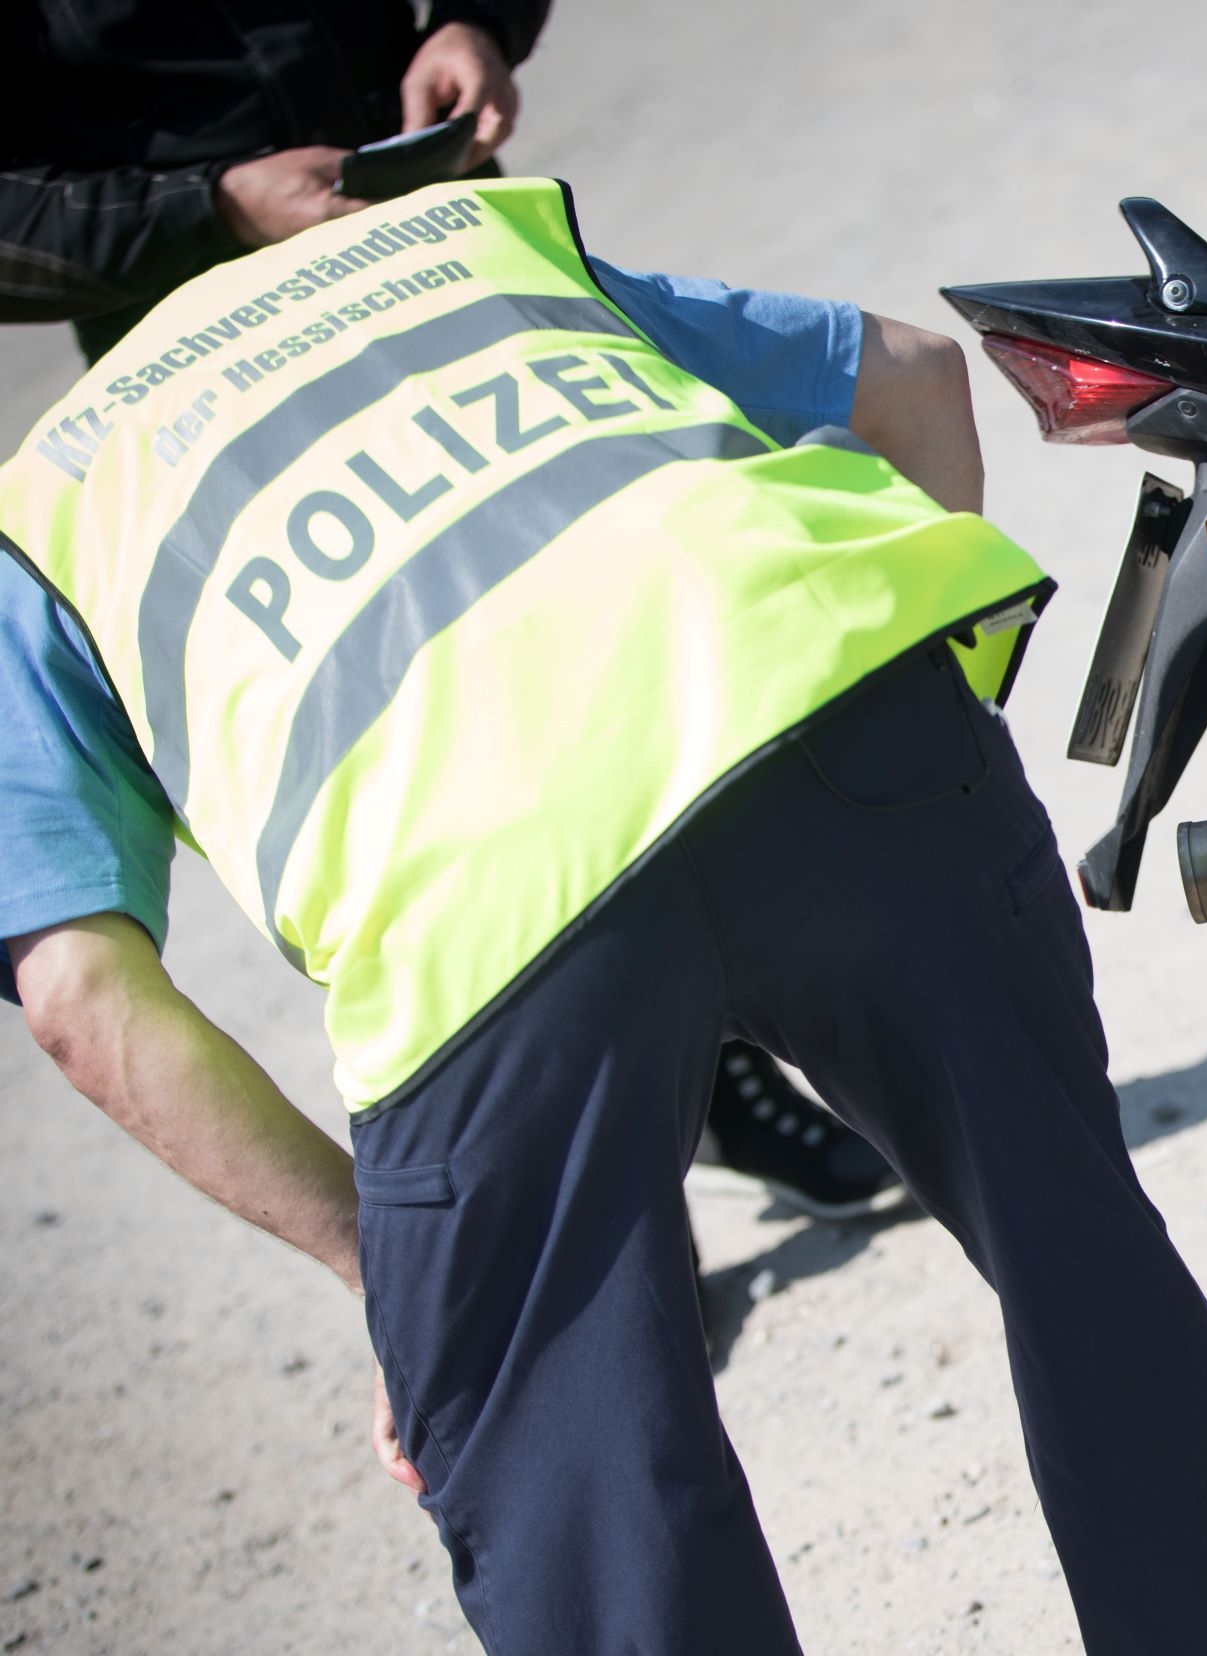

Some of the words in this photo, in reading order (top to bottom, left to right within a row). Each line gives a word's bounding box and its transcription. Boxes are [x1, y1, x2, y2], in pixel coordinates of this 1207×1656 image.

[34, 198, 483, 484] Kfz-Sachverständiger
[150, 389, 218, 469] der
[222, 260, 474, 394] Hessischen
[225, 350, 678, 664] POLIZEI
